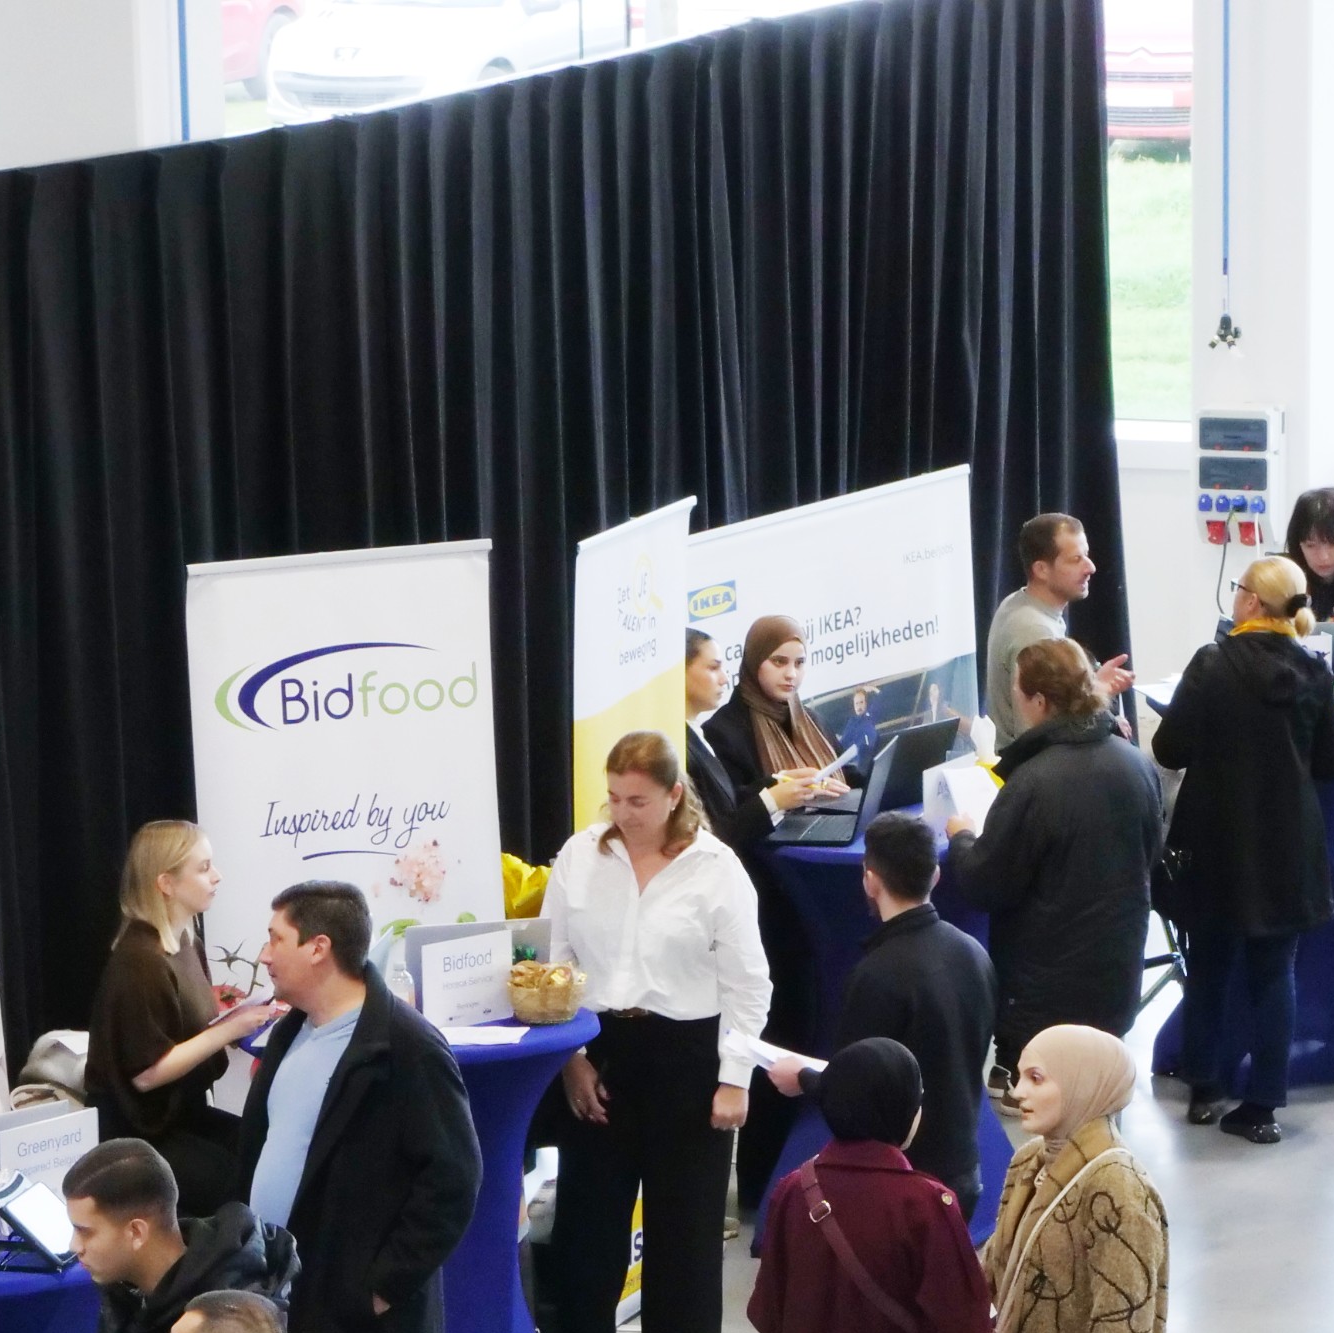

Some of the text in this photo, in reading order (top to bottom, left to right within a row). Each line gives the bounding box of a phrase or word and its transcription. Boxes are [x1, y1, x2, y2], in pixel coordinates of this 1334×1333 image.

[692, 591, 733, 611] IKEA
[819, 606, 862, 637] IKEA?
[619, 638, 657, 665] beweging
[811, 615, 940, 667] mogelijkheden!
[281, 661, 478, 725] Bidfood
[259, 793, 452, 849] Inspired by you
[443, 948, 492, 973] Bidfood
[17, 1128, 82, 1158] Greenyard
